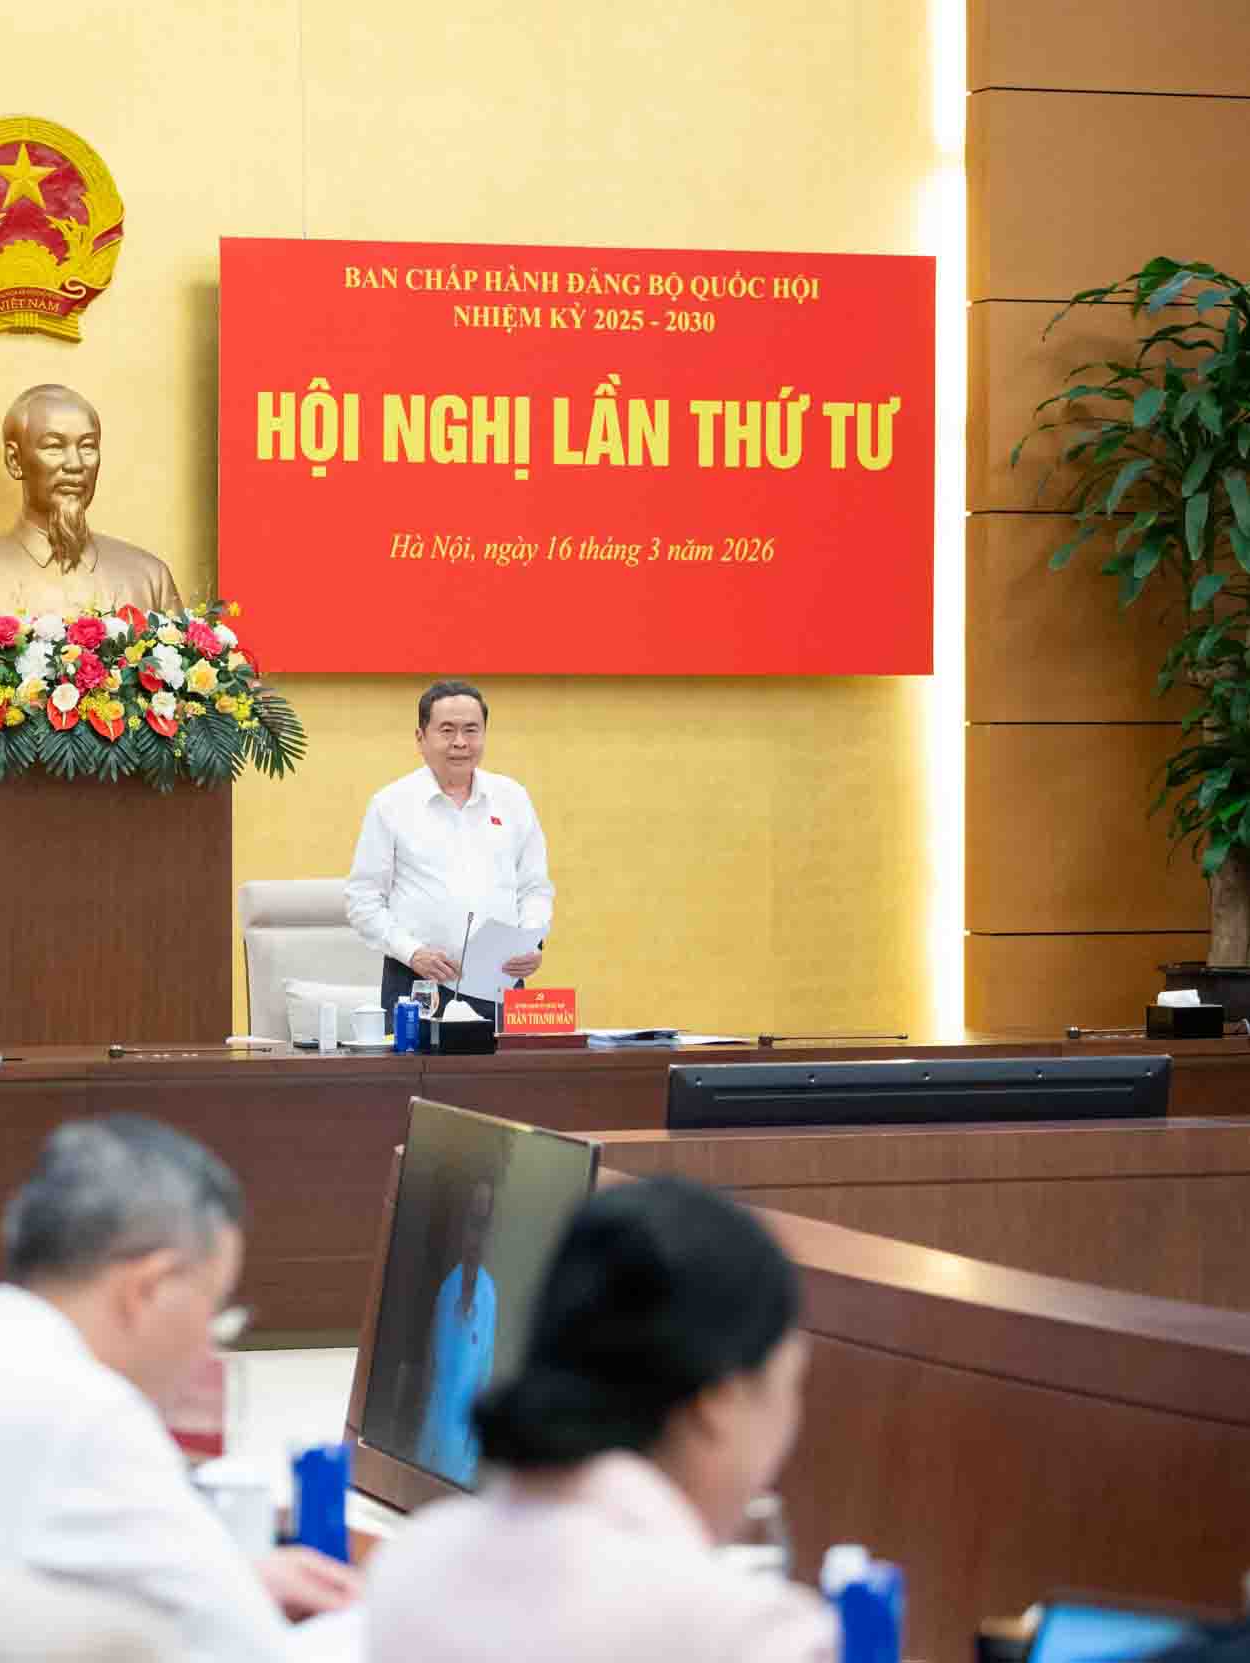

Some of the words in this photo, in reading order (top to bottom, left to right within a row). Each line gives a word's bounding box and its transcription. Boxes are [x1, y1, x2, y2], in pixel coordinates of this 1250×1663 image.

[344, 266, 398, 289] BAN
[405, 263, 478, 291] CHẤP
[485, 264, 559, 293] HÀNH
[566, 267, 640, 296] ĐẢNG
[648, 271, 685, 302] BỘ
[690, 270, 766, 301] QUỐC
[773, 274, 820, 305] HỘI
[453, 304, 542, 334] NHIỆM
[593, 308, 645, 331] 2025
[664, 309, 716, 333] 2030
[256, 376, 360, 477] HỘI
[382, 393, 531, 480] NGHỊ
[552, 372, 670, 467] LẦN
[689, 385, 811, 469] THỨ
[821, 396, 902, 470] TƯ
[389, 533, 425, 559] Hà
[430, 535, 476, 564] Nội,
[483, 535, 539, 567] ngày
[546, 535, 573, 561] 16
[578, 535, 643, 567] tháng
[647, 536, 661, 561] 3
[667, 537, 714, 561] năm
[720, 537, 775, 562] 2026
